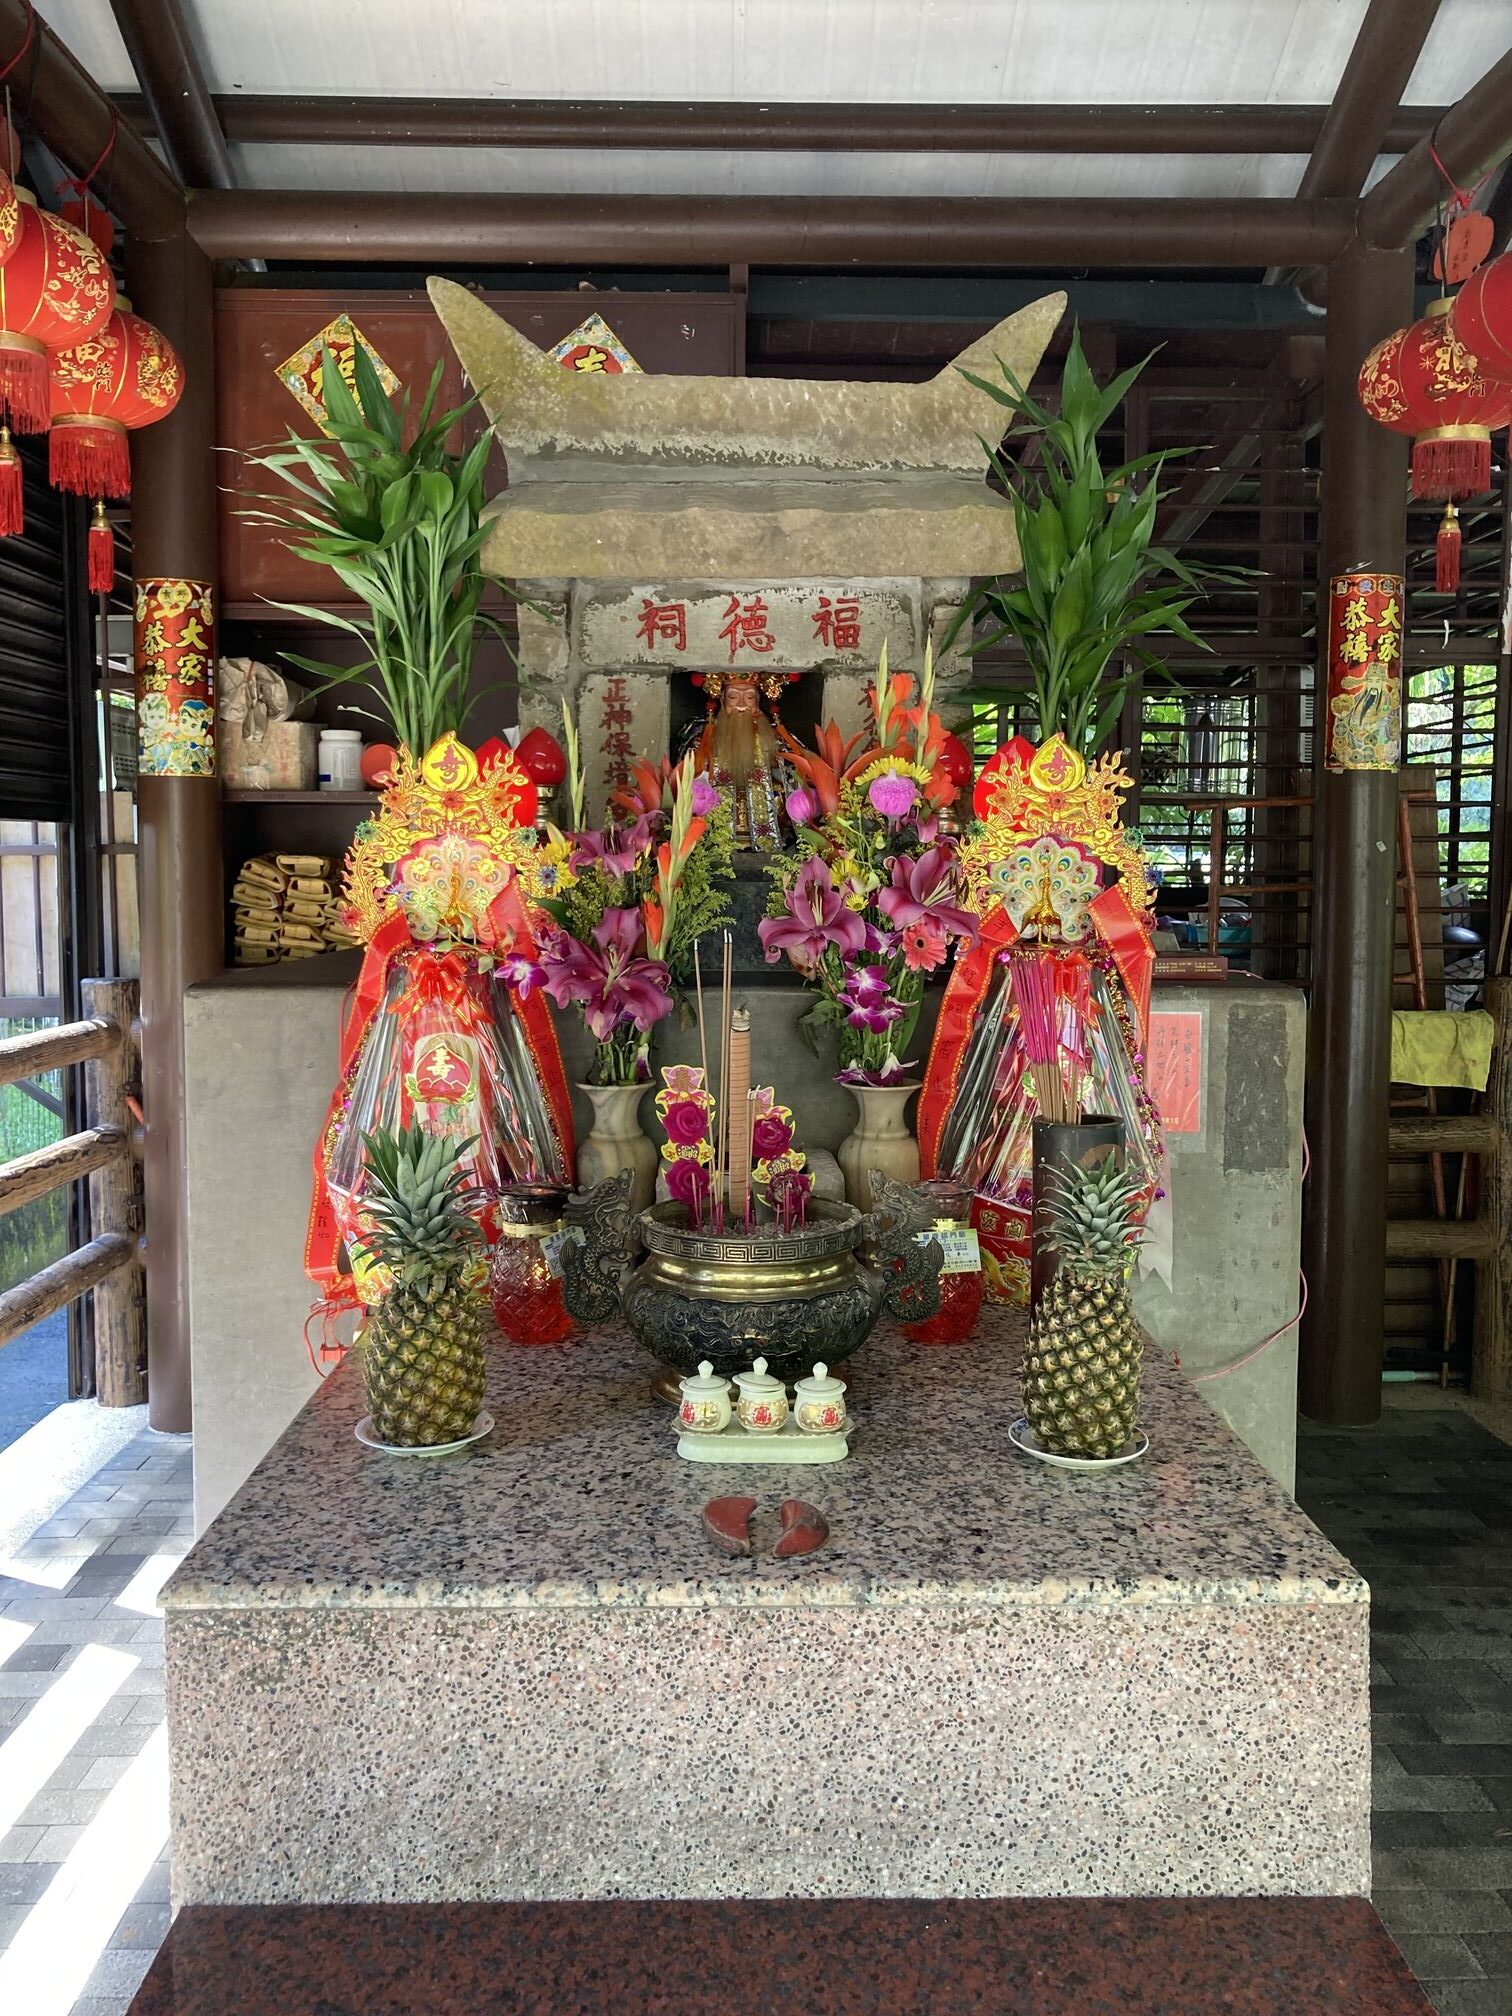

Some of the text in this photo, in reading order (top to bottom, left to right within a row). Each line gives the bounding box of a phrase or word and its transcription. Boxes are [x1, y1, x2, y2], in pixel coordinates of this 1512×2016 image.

[175, 616, 209, 686] 大家
[636, 595, 862, 664] 福德祠
[1340, 596, 1374, 663] 恭禧
[1377, 597, 1401, 662] 大家
